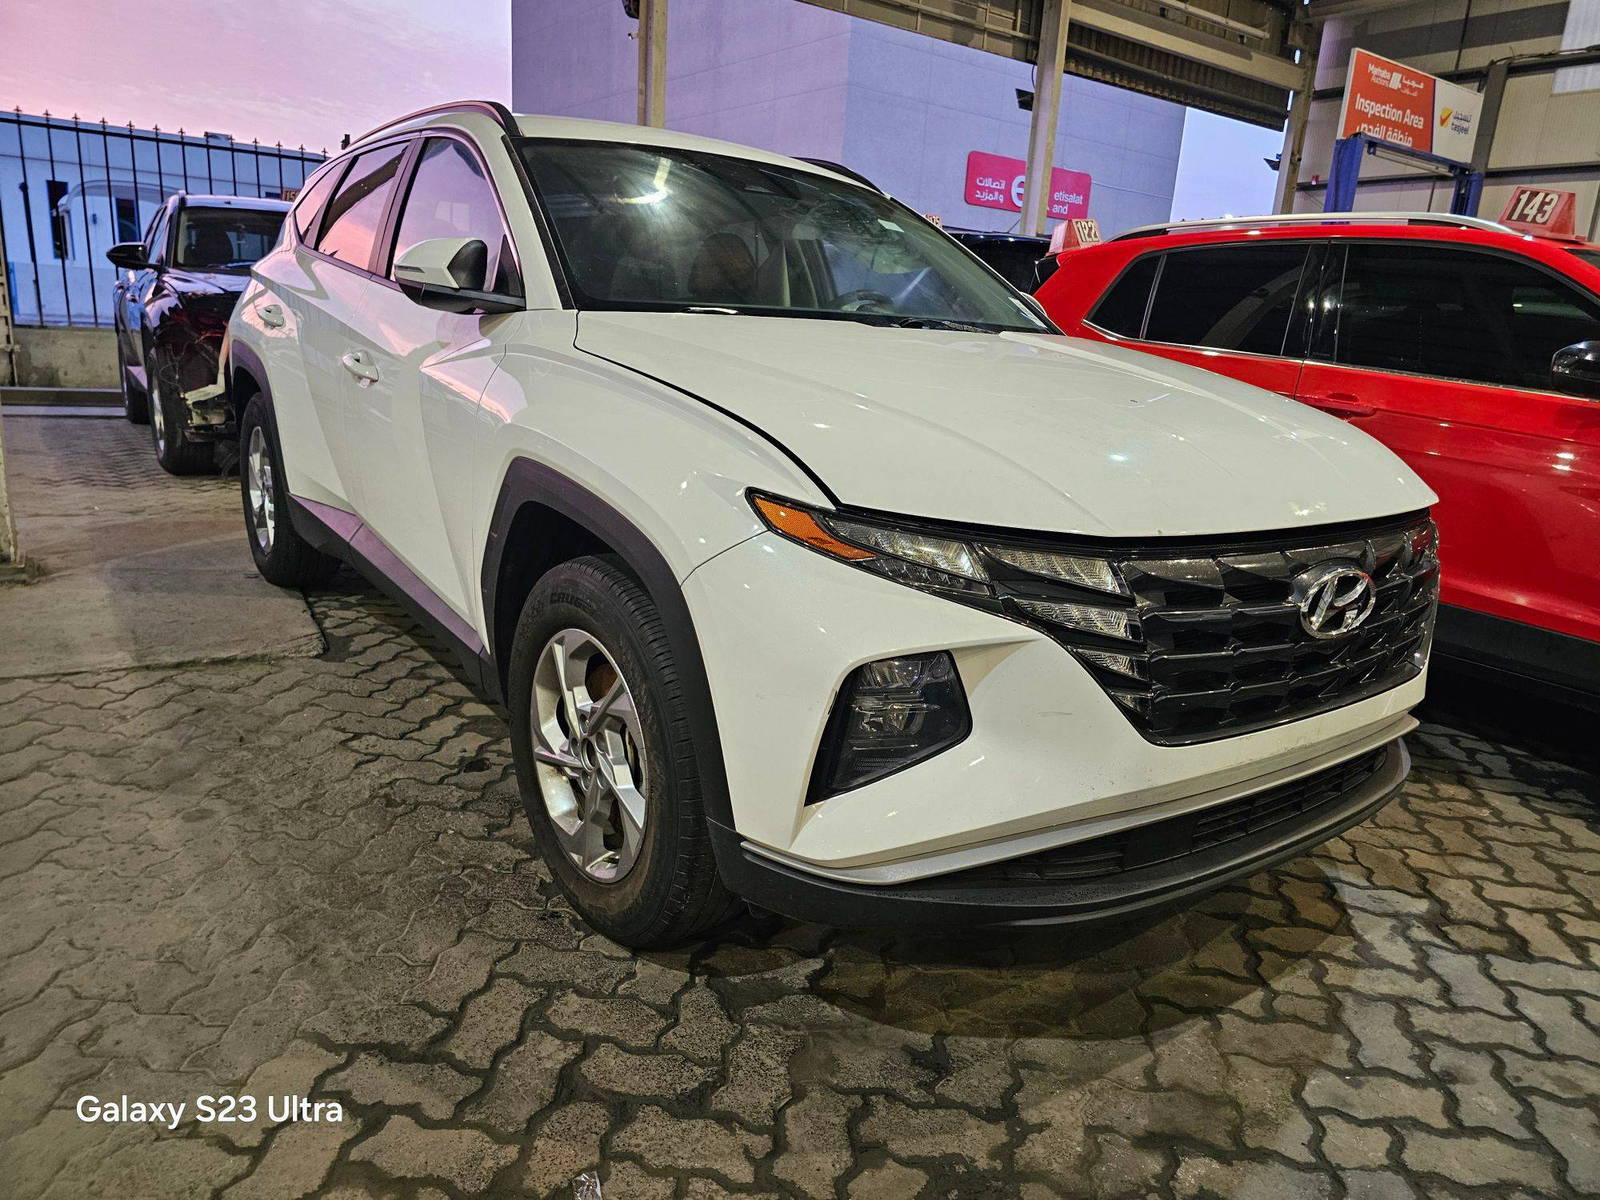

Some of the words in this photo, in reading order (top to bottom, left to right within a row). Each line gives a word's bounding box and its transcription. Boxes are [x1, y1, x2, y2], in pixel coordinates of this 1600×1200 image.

[1355, 93, 1402, 122] Inspection
[1403, 109, 1424, 129] Area
[976, 177, 1006, 190] اتصالات
[1054, 191, 1084, 205] etisalat
[1511, 190, 1559, 224] 143
[1052, 204, 1068, 215] and
[1076, 220, 1099, 242] 122
